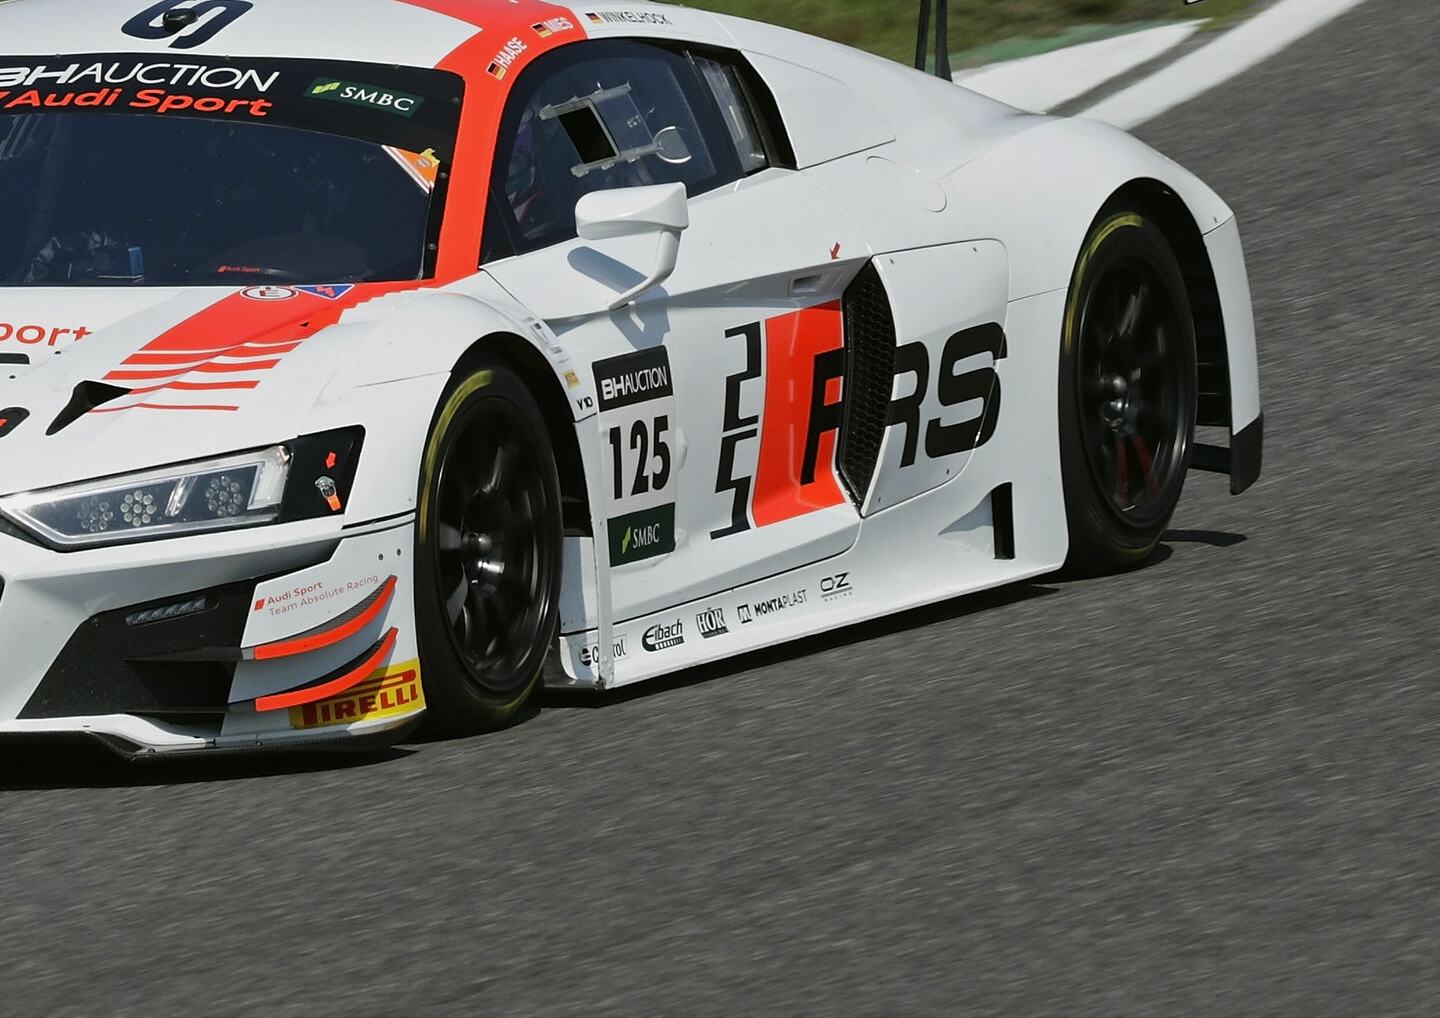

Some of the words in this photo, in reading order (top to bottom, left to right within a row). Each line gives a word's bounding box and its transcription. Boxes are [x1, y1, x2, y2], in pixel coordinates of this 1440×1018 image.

[598, 11, 672, 26] WINKELHOCK
[494, 37, 528, 70] HAASE
[5, 89, 121, 109] Audi
[128, 89, 274, 117] Sport
[340, 86, 414, 112] SMBC
[600, 365, 669, 402] BHAUCTION
[799, 321, 1009, 487] RS
[609, 414, 672, 501] 125
[632, 523, 661, 550] SMBC
[267, 589, 292, 606] Audi
[293, 581, 324, 599] Sport
[269, 601, 298, 617] Team
[300, 586, 346, 608] Absolute
[347, 573, 380, 592] Racing
[820, 572, 850, 593] OZ
[754, 590, 808, 617] MONTAPLAST
[641, 618, 684, 651] Eibach
[592, 638, 627, 663] Crol
[302, 669, 419, 727] PIRELLI
